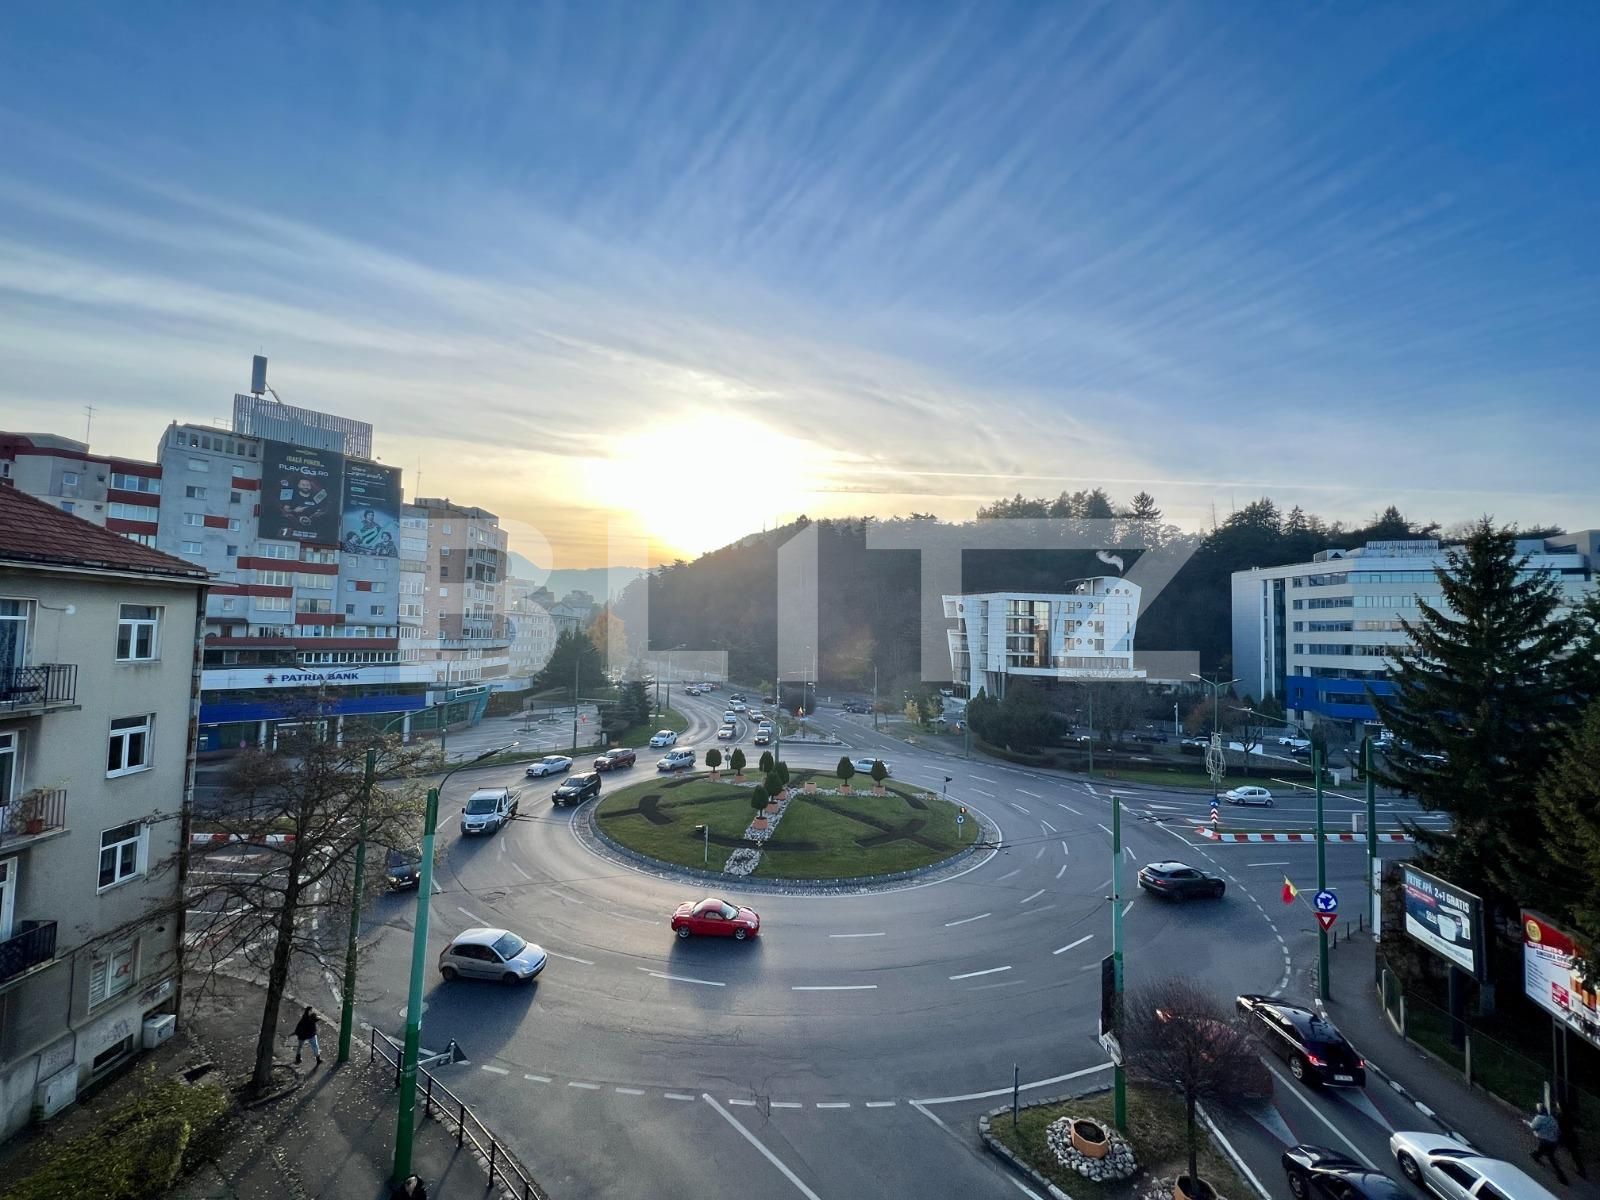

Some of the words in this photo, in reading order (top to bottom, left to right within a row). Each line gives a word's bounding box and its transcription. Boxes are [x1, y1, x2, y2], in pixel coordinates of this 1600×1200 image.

[281, 674, 324, 682] PATRIA
[327, 672, 359, 681] BANK
[1446, 893, 1470, 914] GRATIS
